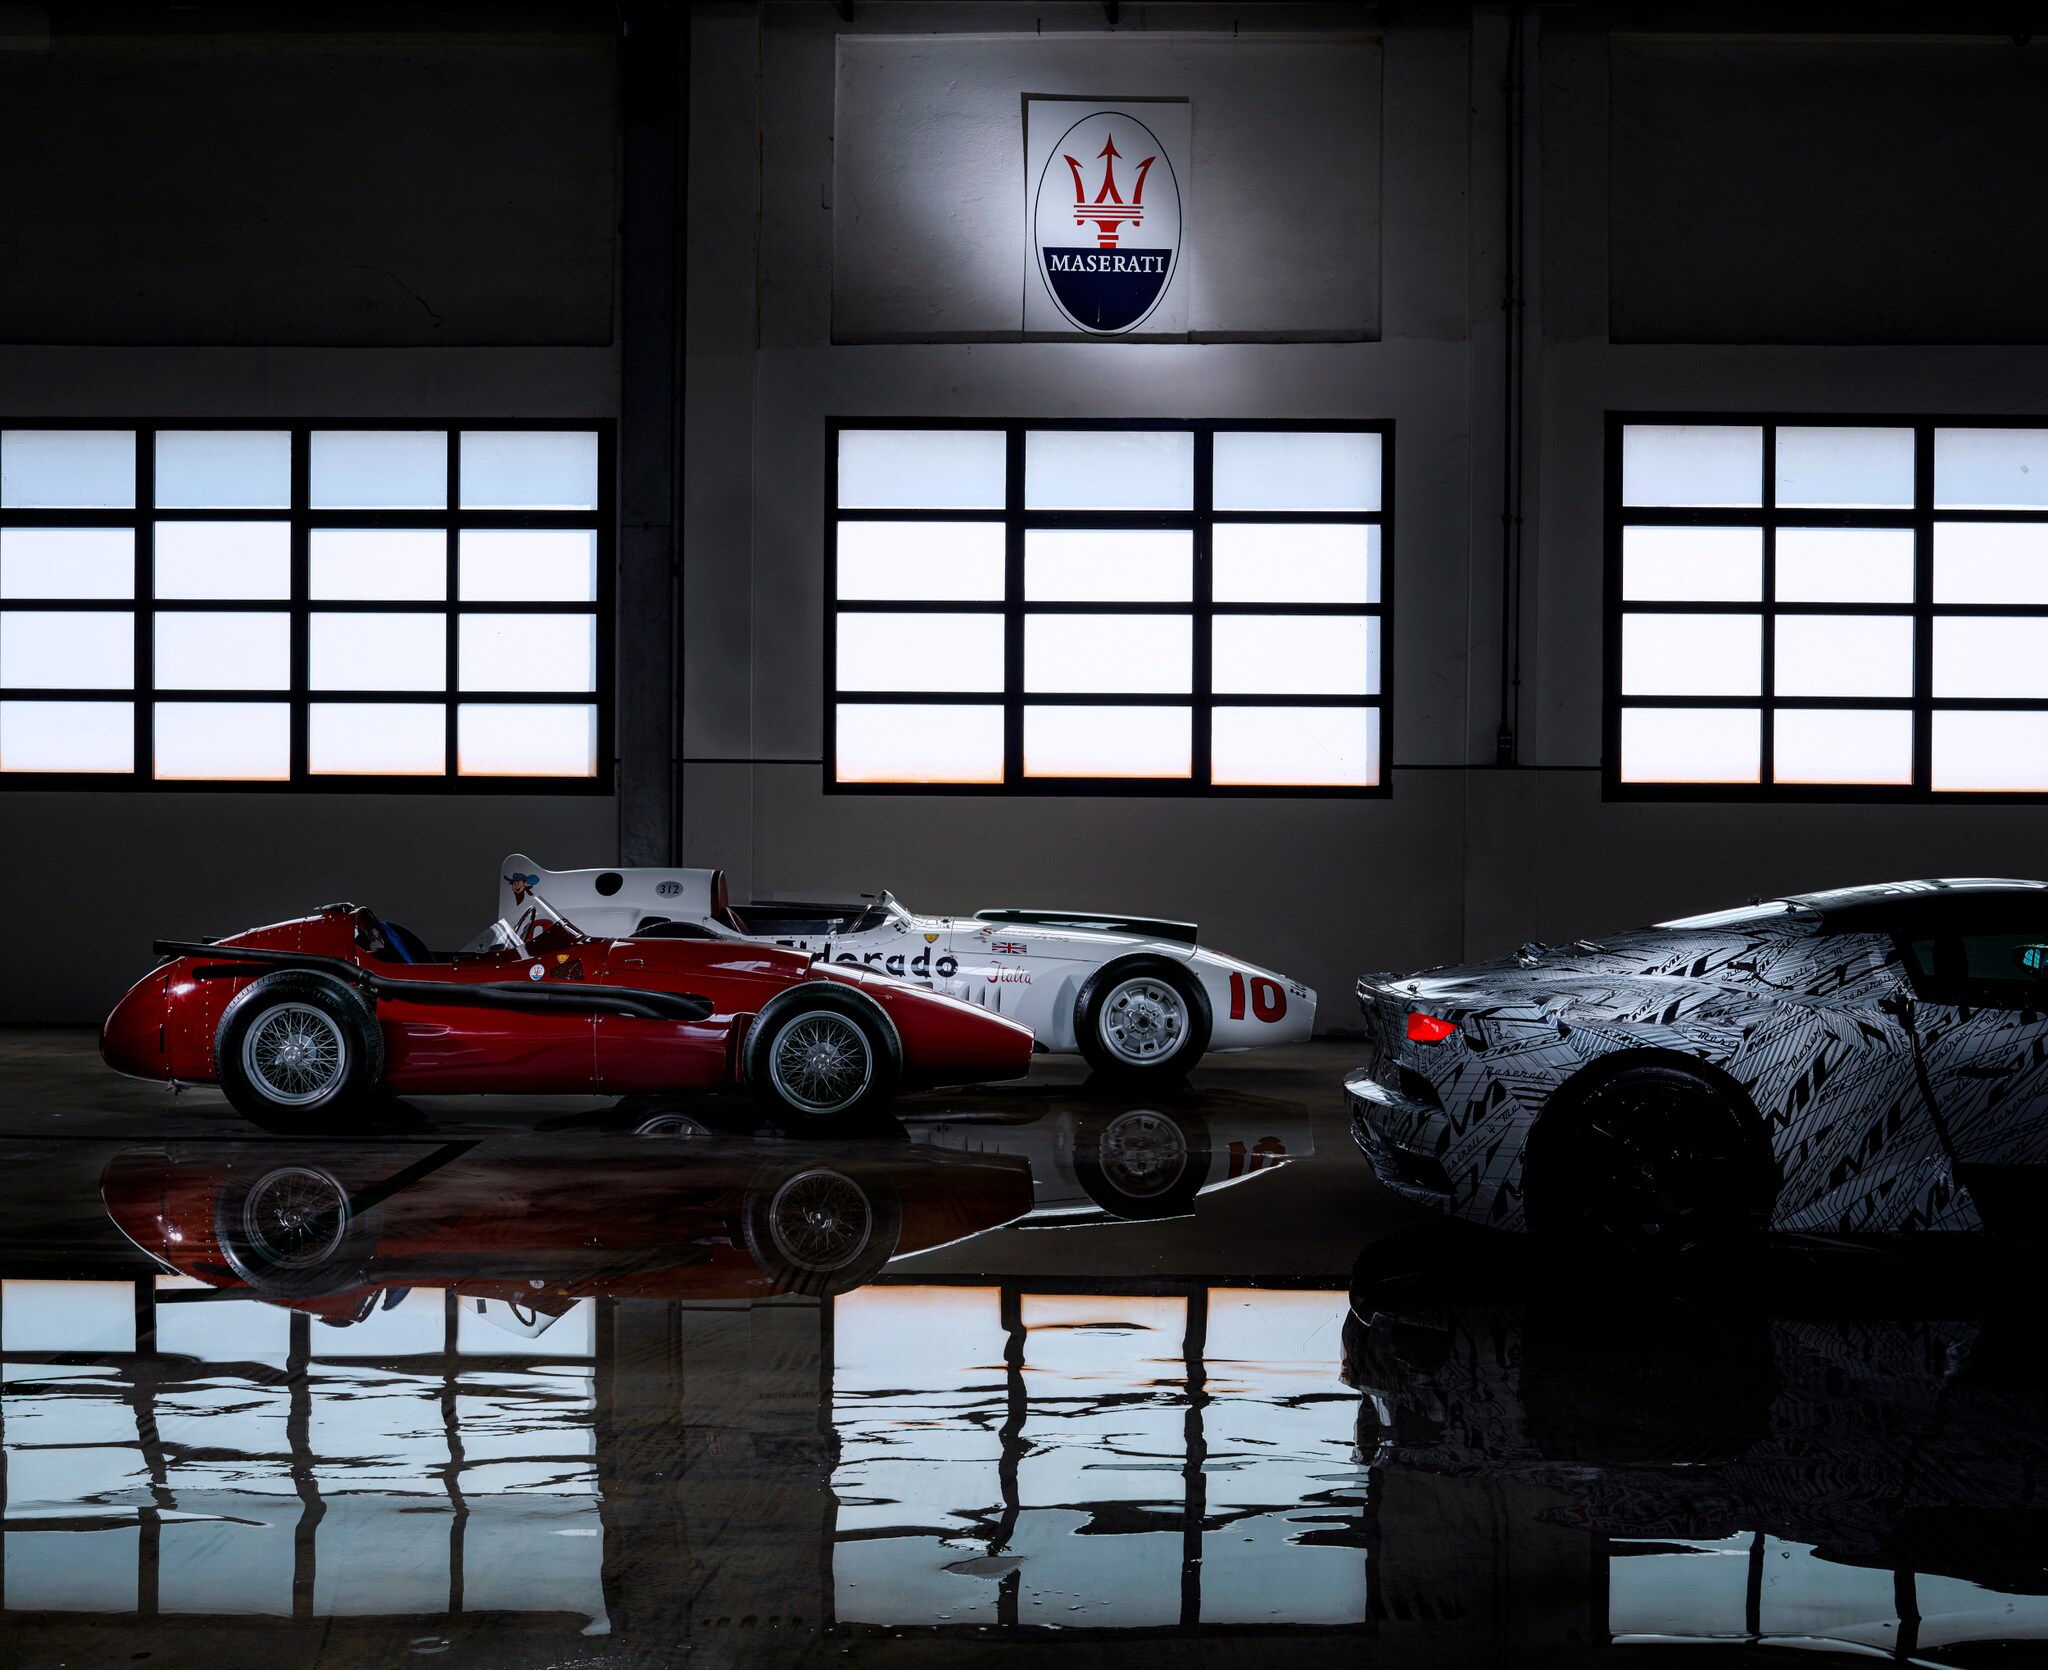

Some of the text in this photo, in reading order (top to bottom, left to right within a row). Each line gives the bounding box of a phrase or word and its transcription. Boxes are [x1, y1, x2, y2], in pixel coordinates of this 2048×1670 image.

[1050, 254, 1164, 273] MASERATI
[659, 884, 679, 894] 312
[986, 960, 1032, 985] Italia
[1229, 971, 1287, 1023] 10
